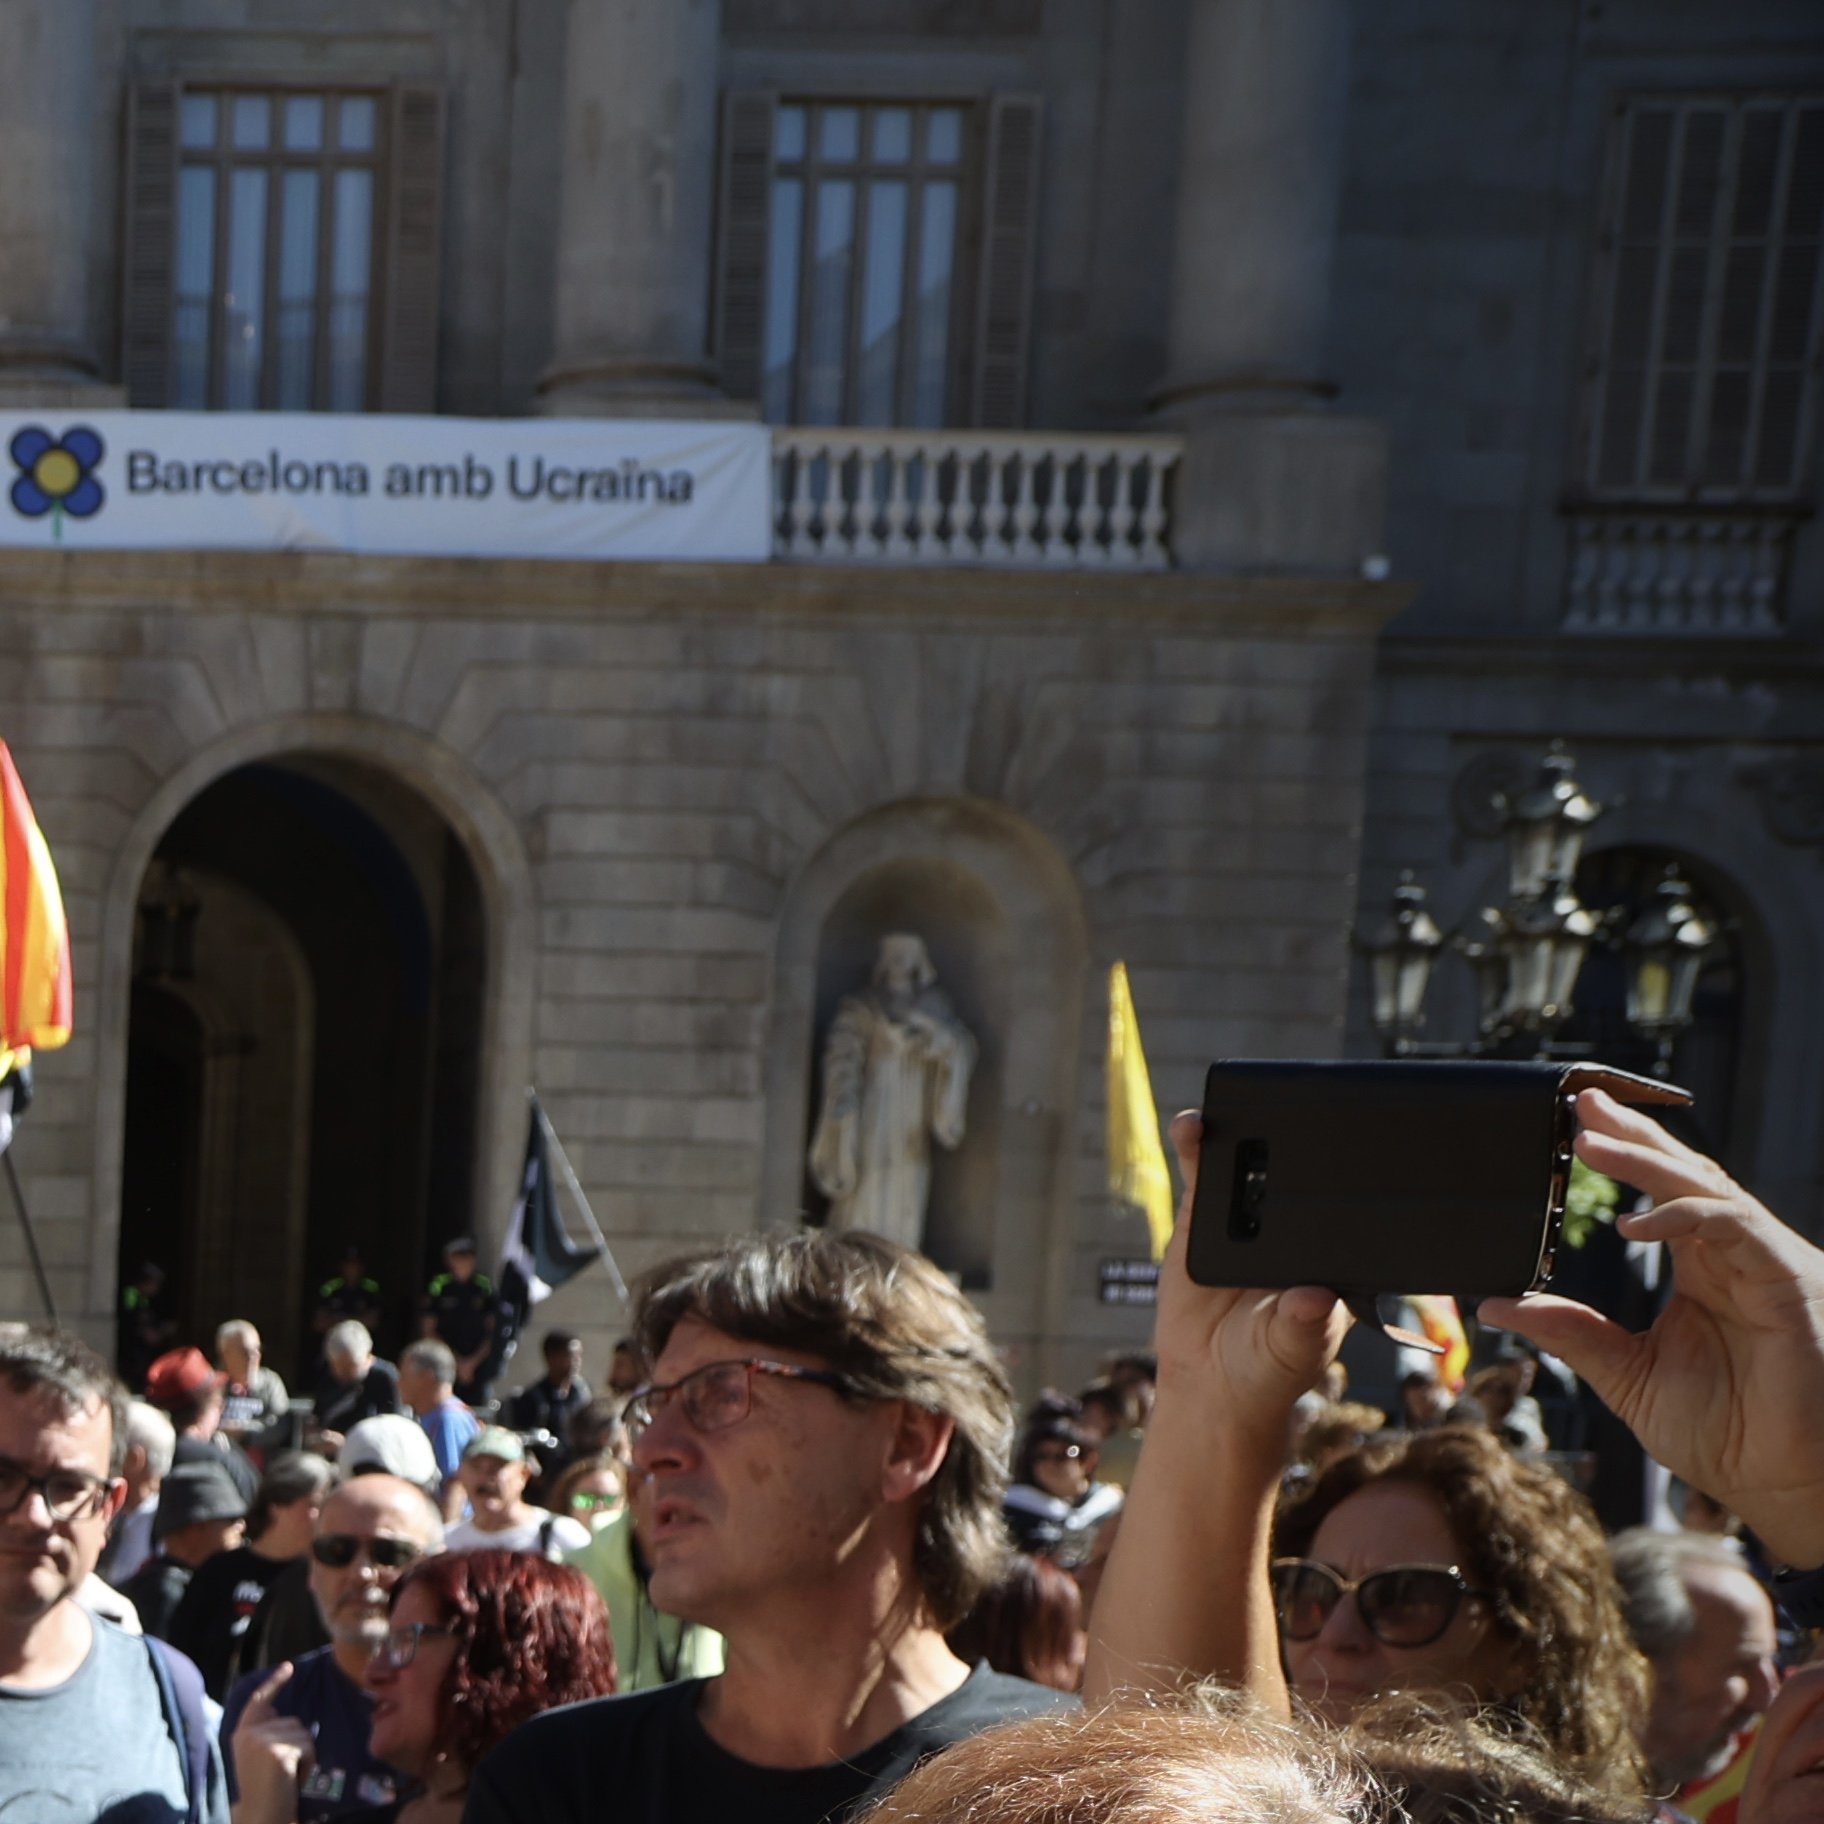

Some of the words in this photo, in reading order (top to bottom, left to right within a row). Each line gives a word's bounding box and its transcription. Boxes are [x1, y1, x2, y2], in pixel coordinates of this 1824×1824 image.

[125, 449, 370, 498] Barcelona
[385, 453, 494, 502] amb
[506, 455, 694, 506] Ucraïna
